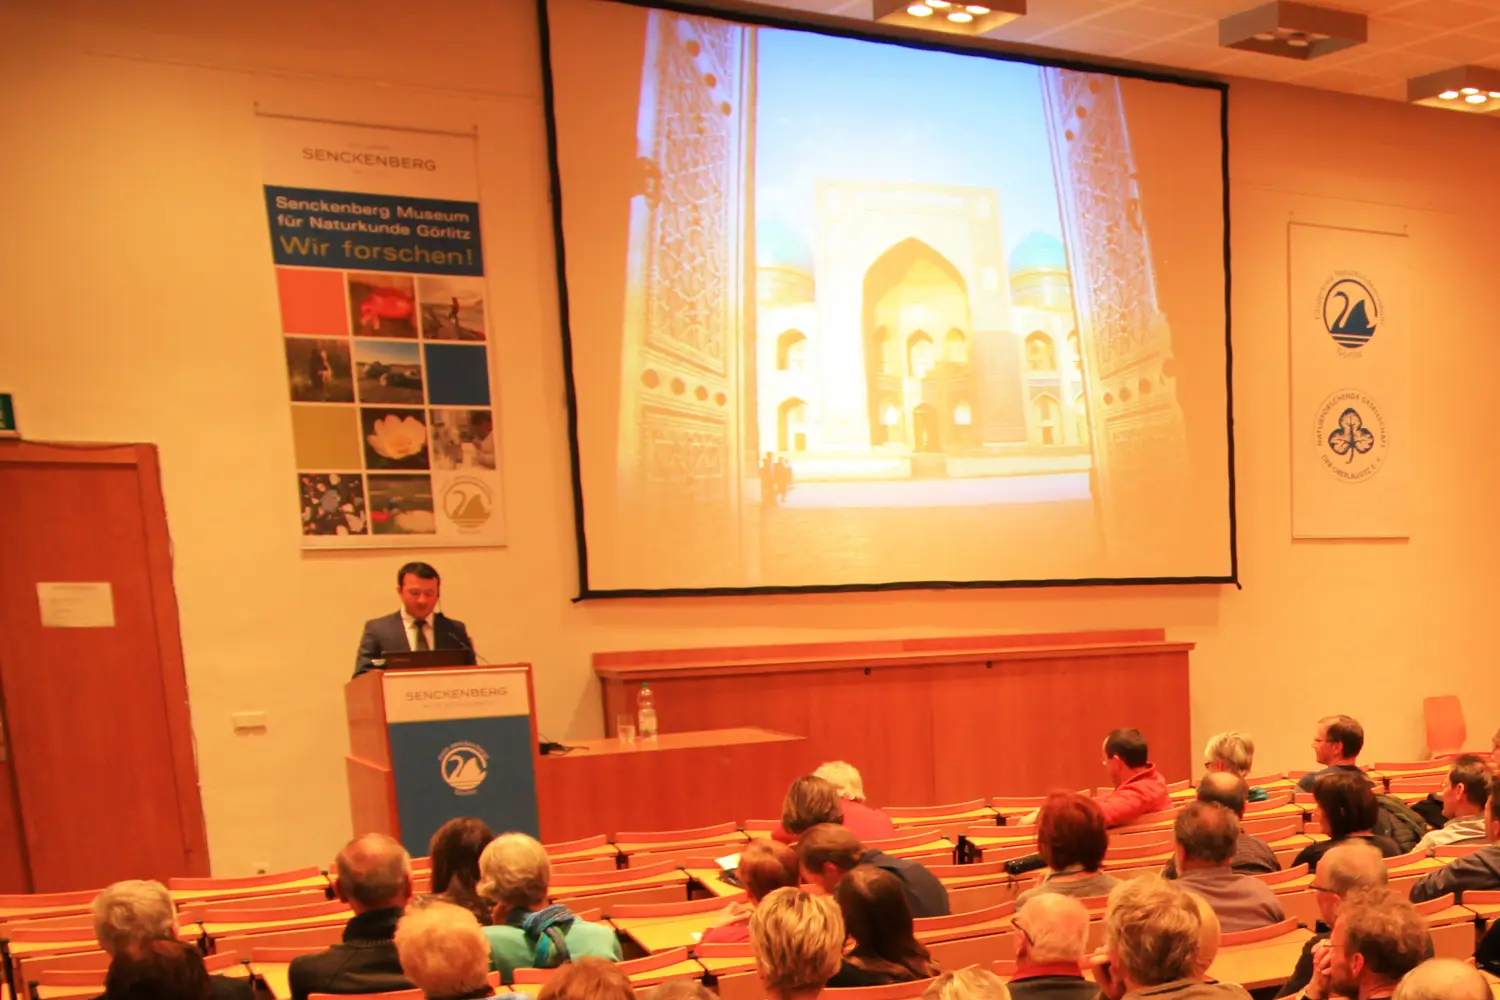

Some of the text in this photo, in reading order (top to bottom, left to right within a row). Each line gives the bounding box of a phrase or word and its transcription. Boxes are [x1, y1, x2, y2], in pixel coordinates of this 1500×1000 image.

[302, 147, 437, 171] SENCKENBERG
[275, 195, 470, 223] Senckenberg Museum
[277, 213, 471, 240] für Naturkunde Görlitz
[279, 235, 473, 266] Wir forschen!
[405, 686, 508, 701] SENCKENBERG
